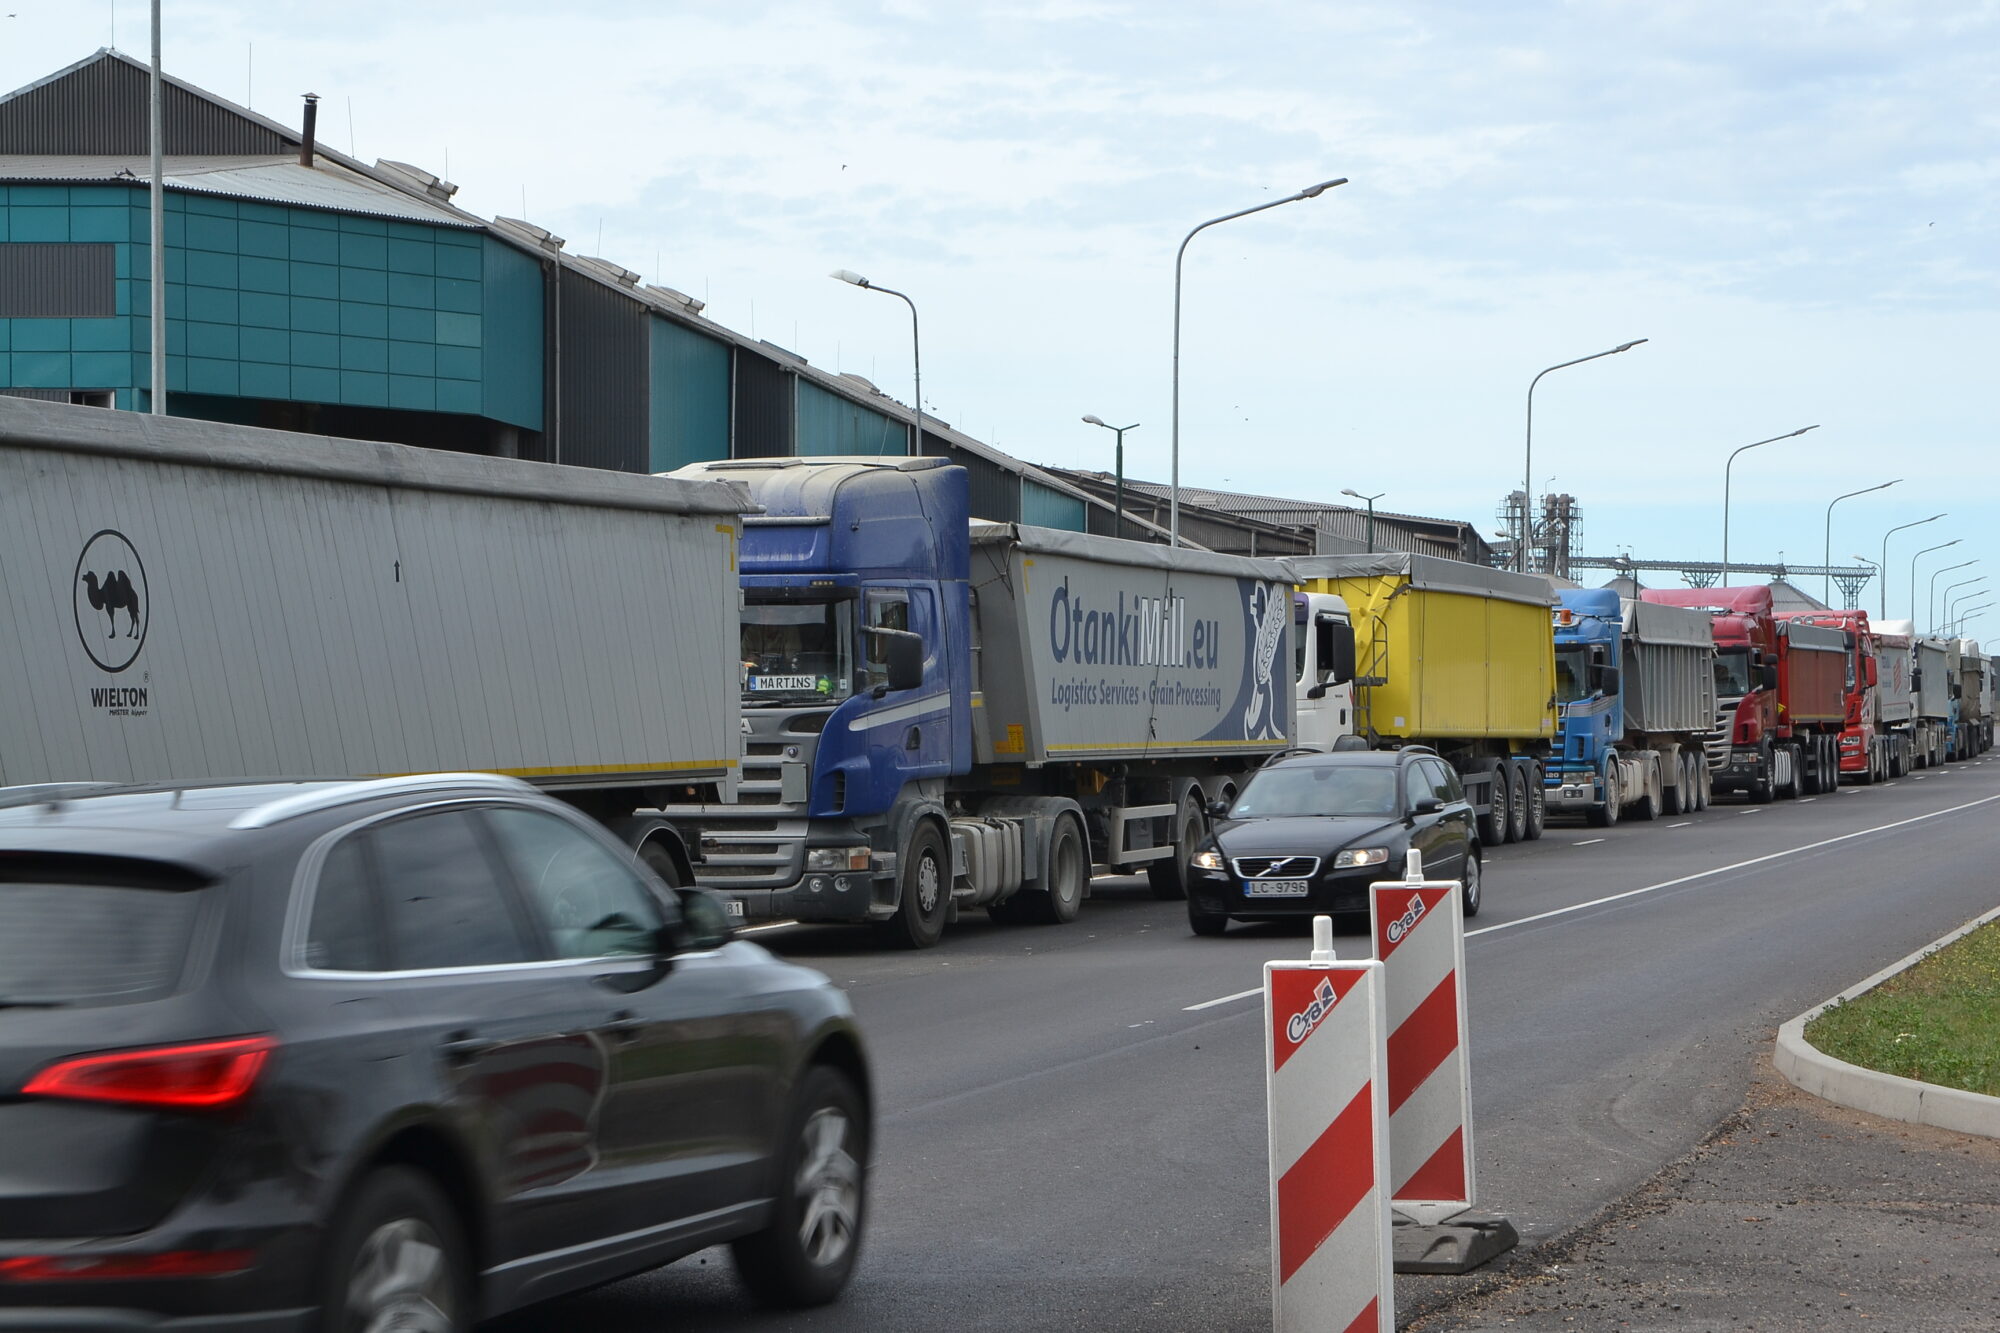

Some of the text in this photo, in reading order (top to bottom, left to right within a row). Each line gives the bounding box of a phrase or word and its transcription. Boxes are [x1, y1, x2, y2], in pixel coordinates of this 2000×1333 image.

[760, 677, 811, 689] MARTINS
[91, 687, 148, 708] WIELTON
[1051, 677, 1221, 712] Logistics Services Grain Processing
[1252, 882, 1306, 894] LC-9796
